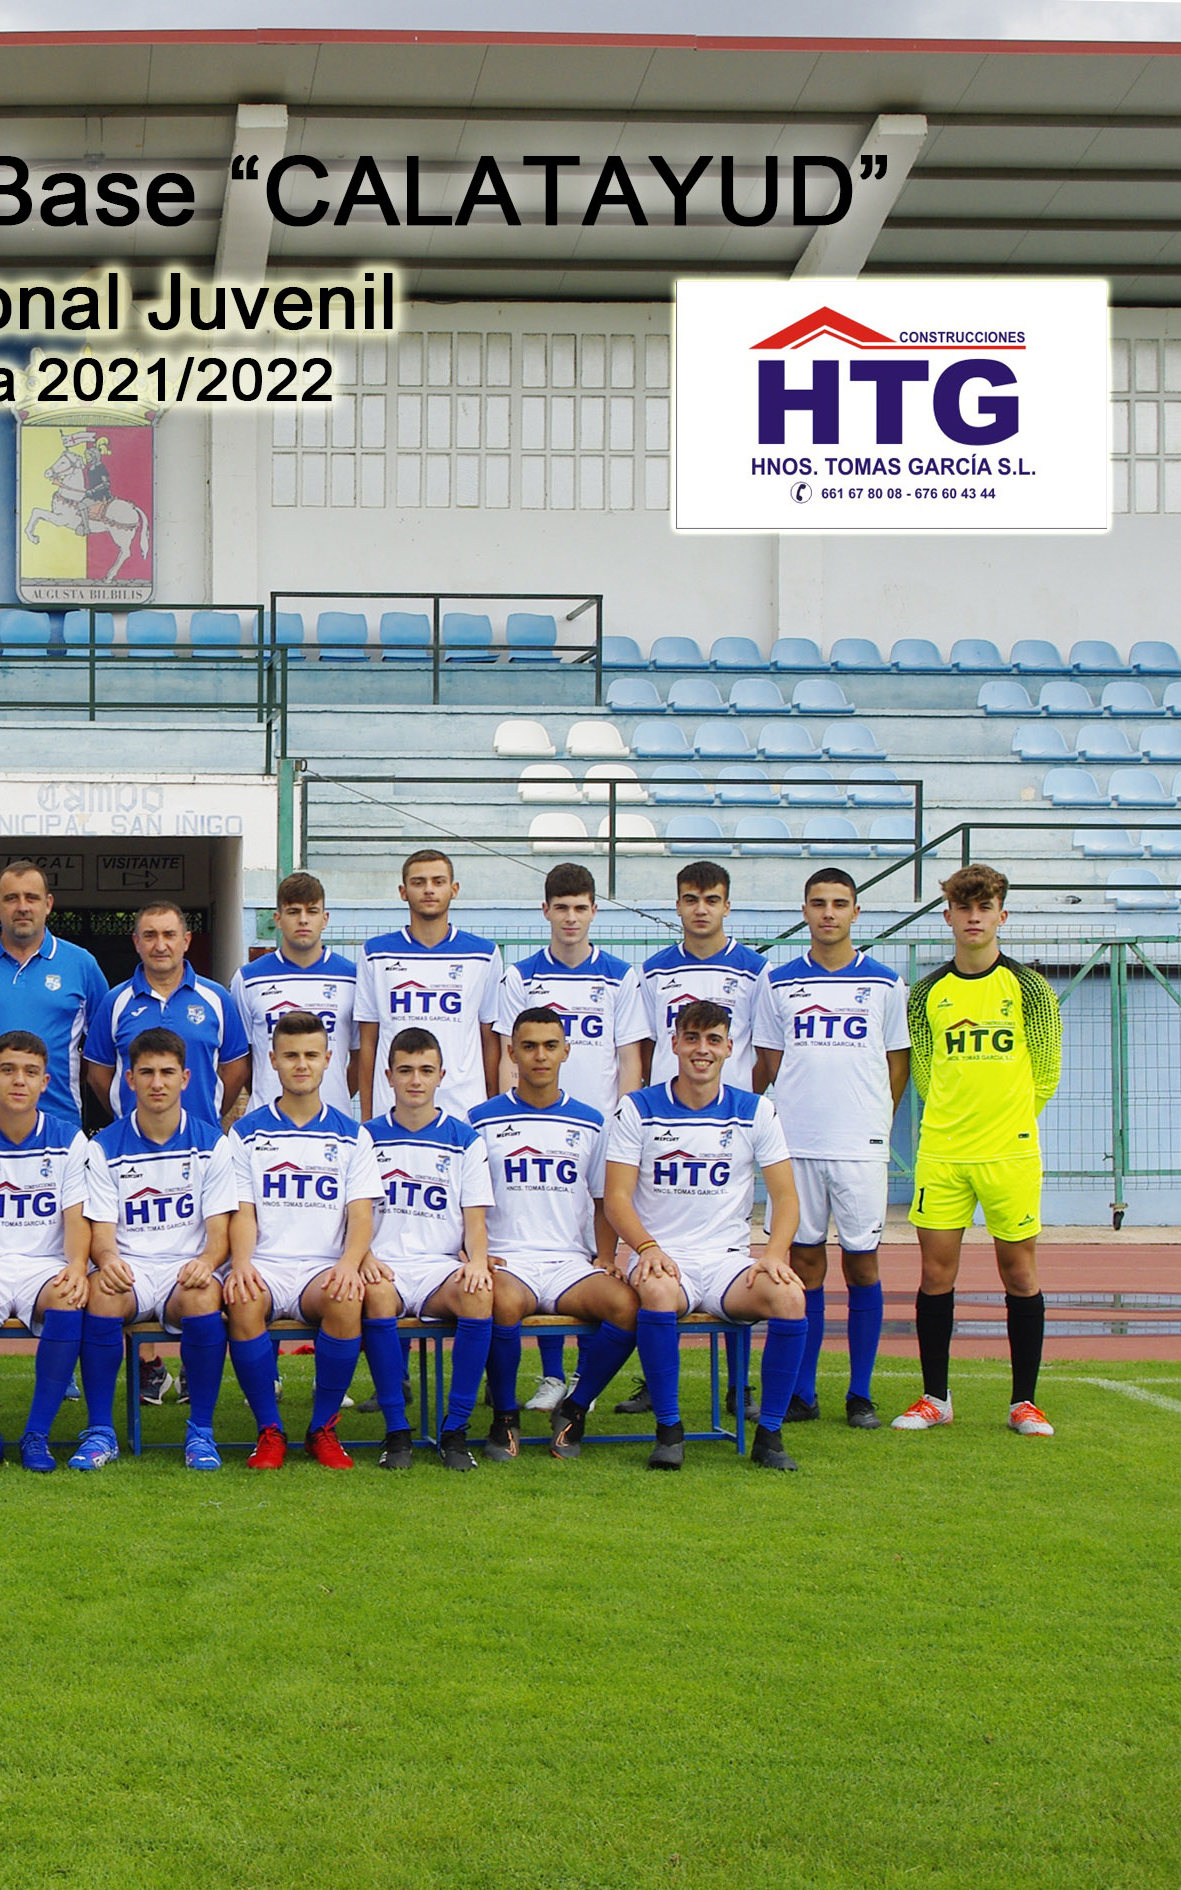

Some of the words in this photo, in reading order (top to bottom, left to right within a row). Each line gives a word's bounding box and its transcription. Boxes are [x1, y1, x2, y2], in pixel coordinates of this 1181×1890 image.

[31, 589, 85, 600] AUGUSTA
[89, 589, 143, 600] BILBILIS
[111, 814, 162, 836] SAN
[175, 810, 243, 836] IÑIGO
[102, 857, 180, 869] VISITANTE
[390, 991, 462, 1014] HTG
[794, 1016, 867, 1039] HTG
[945, 1029, 1014, 1054] HTG
[504, 1159, 577, 1184] HTG
[654, 1162, 730, 1186] HTG
[263, 1174, 338, 1200] HTG
[125, 1193, 194, 1225] HTG
[916, 1187, 925, 1214] 1
